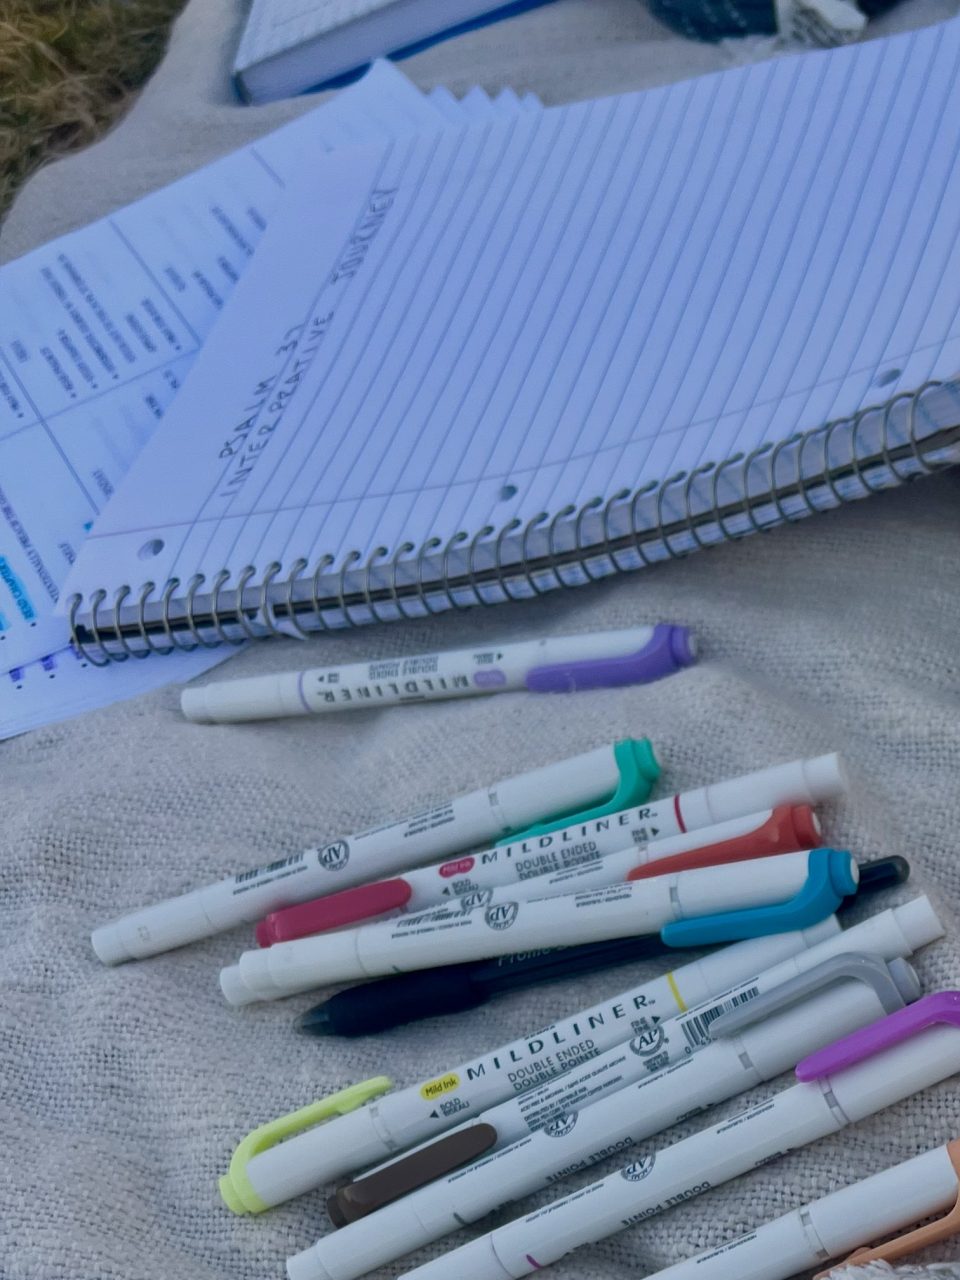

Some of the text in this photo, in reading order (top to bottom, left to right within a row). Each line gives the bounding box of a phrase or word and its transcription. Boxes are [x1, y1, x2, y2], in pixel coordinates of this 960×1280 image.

[218, 375, 277, 460] PSALM
[324, 674, 469, 703] MILDLINER
[481, 807, 652, 865] MILDLINER
[515, 841, 598, 873] DOUBLE ENDED
[466, 993, 651, 1081] MILDLINER
[507, 1039, 595, 1083] DOUBLE ENDED
[513, 1048, 601, 1092] DOUBLE POINTE
[425, 1077, 457, 1097] Mild Ink
[440, 1097, 461, 1110] BOLD
[621, 1180, 711, 1226] DOUBLE POINTE
